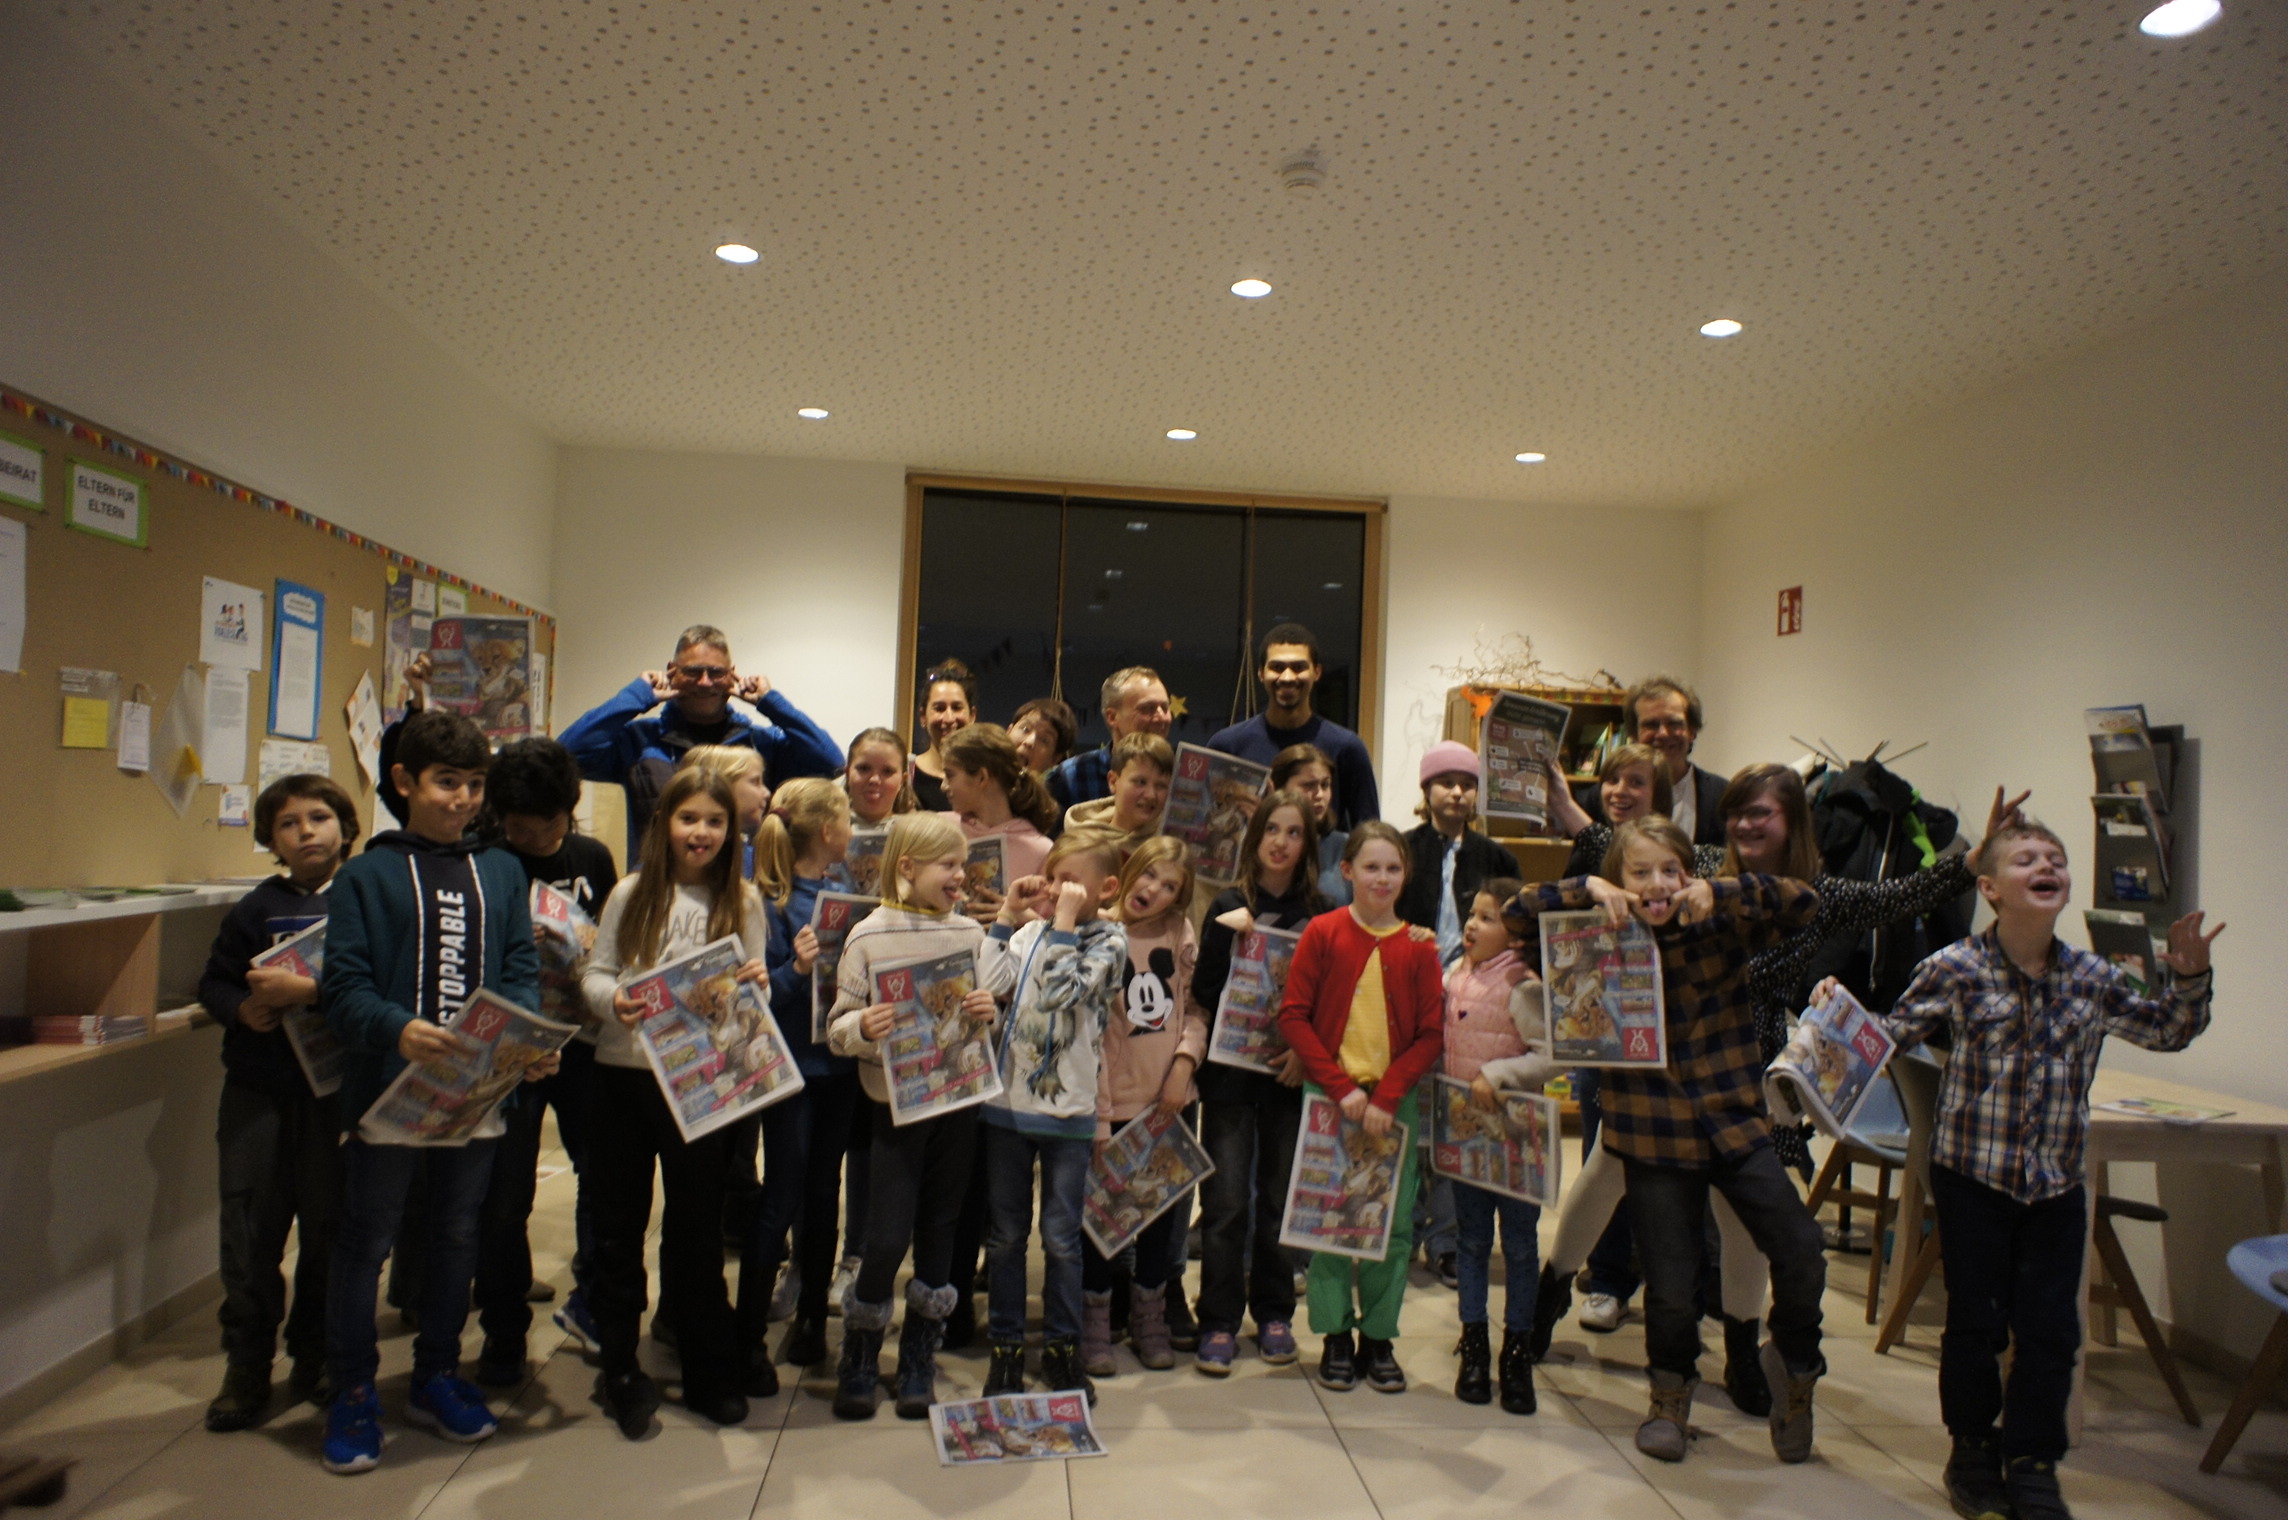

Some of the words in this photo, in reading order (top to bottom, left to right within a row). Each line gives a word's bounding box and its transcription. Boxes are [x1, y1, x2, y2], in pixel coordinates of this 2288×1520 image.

[78, 475, 116, 497] ELTERN
[117, 487, 135, 504] FÜR
[88, 498, 125, 519] ELTERN
[436, 889, 466, 1031] STOPPABLE
